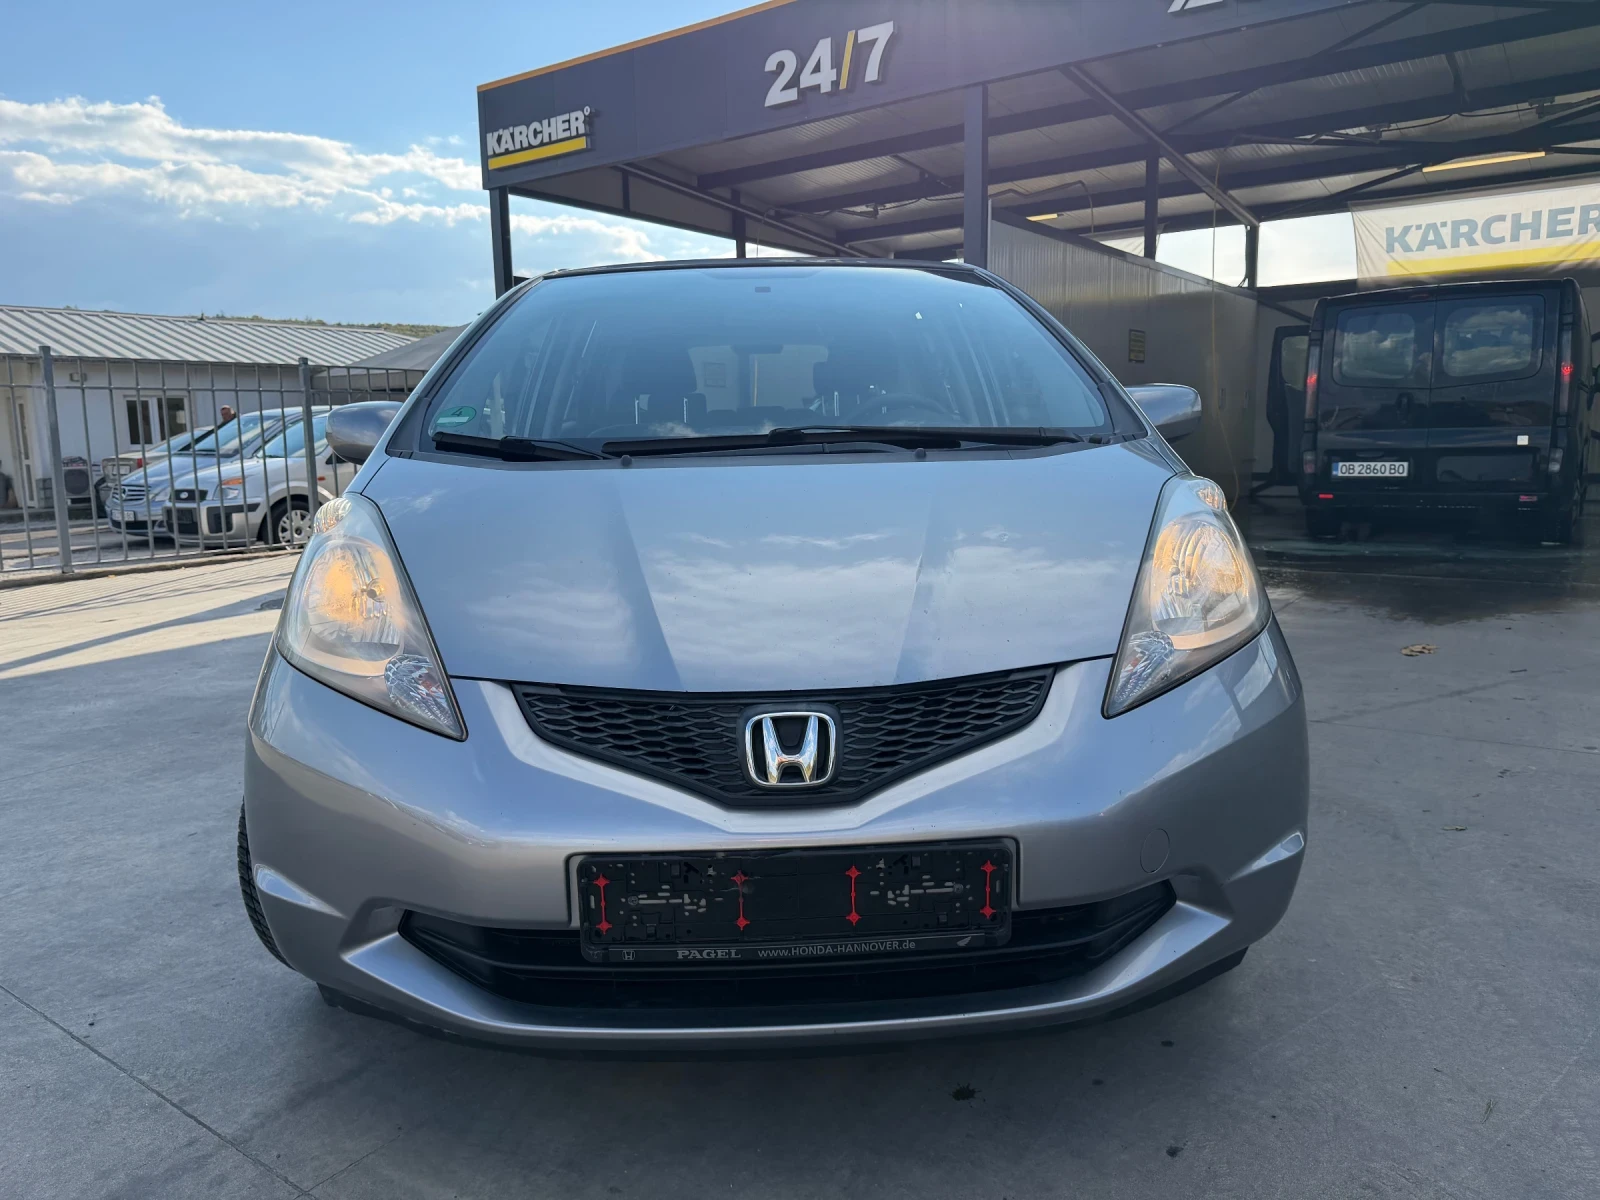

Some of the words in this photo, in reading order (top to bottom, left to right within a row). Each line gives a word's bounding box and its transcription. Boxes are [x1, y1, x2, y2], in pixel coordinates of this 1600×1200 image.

[764, 21, 894, 107] 24/7
[486, 110, 586, 156] KÄRCHER
[1385, 203, 1600, 254] KÄRCHER
[1357, 463, 1387, 475] 2860
[676, 948, 742, 960] PAGEL
[757, 939, 916, 958] www.HONDA-HANNOVER.de
